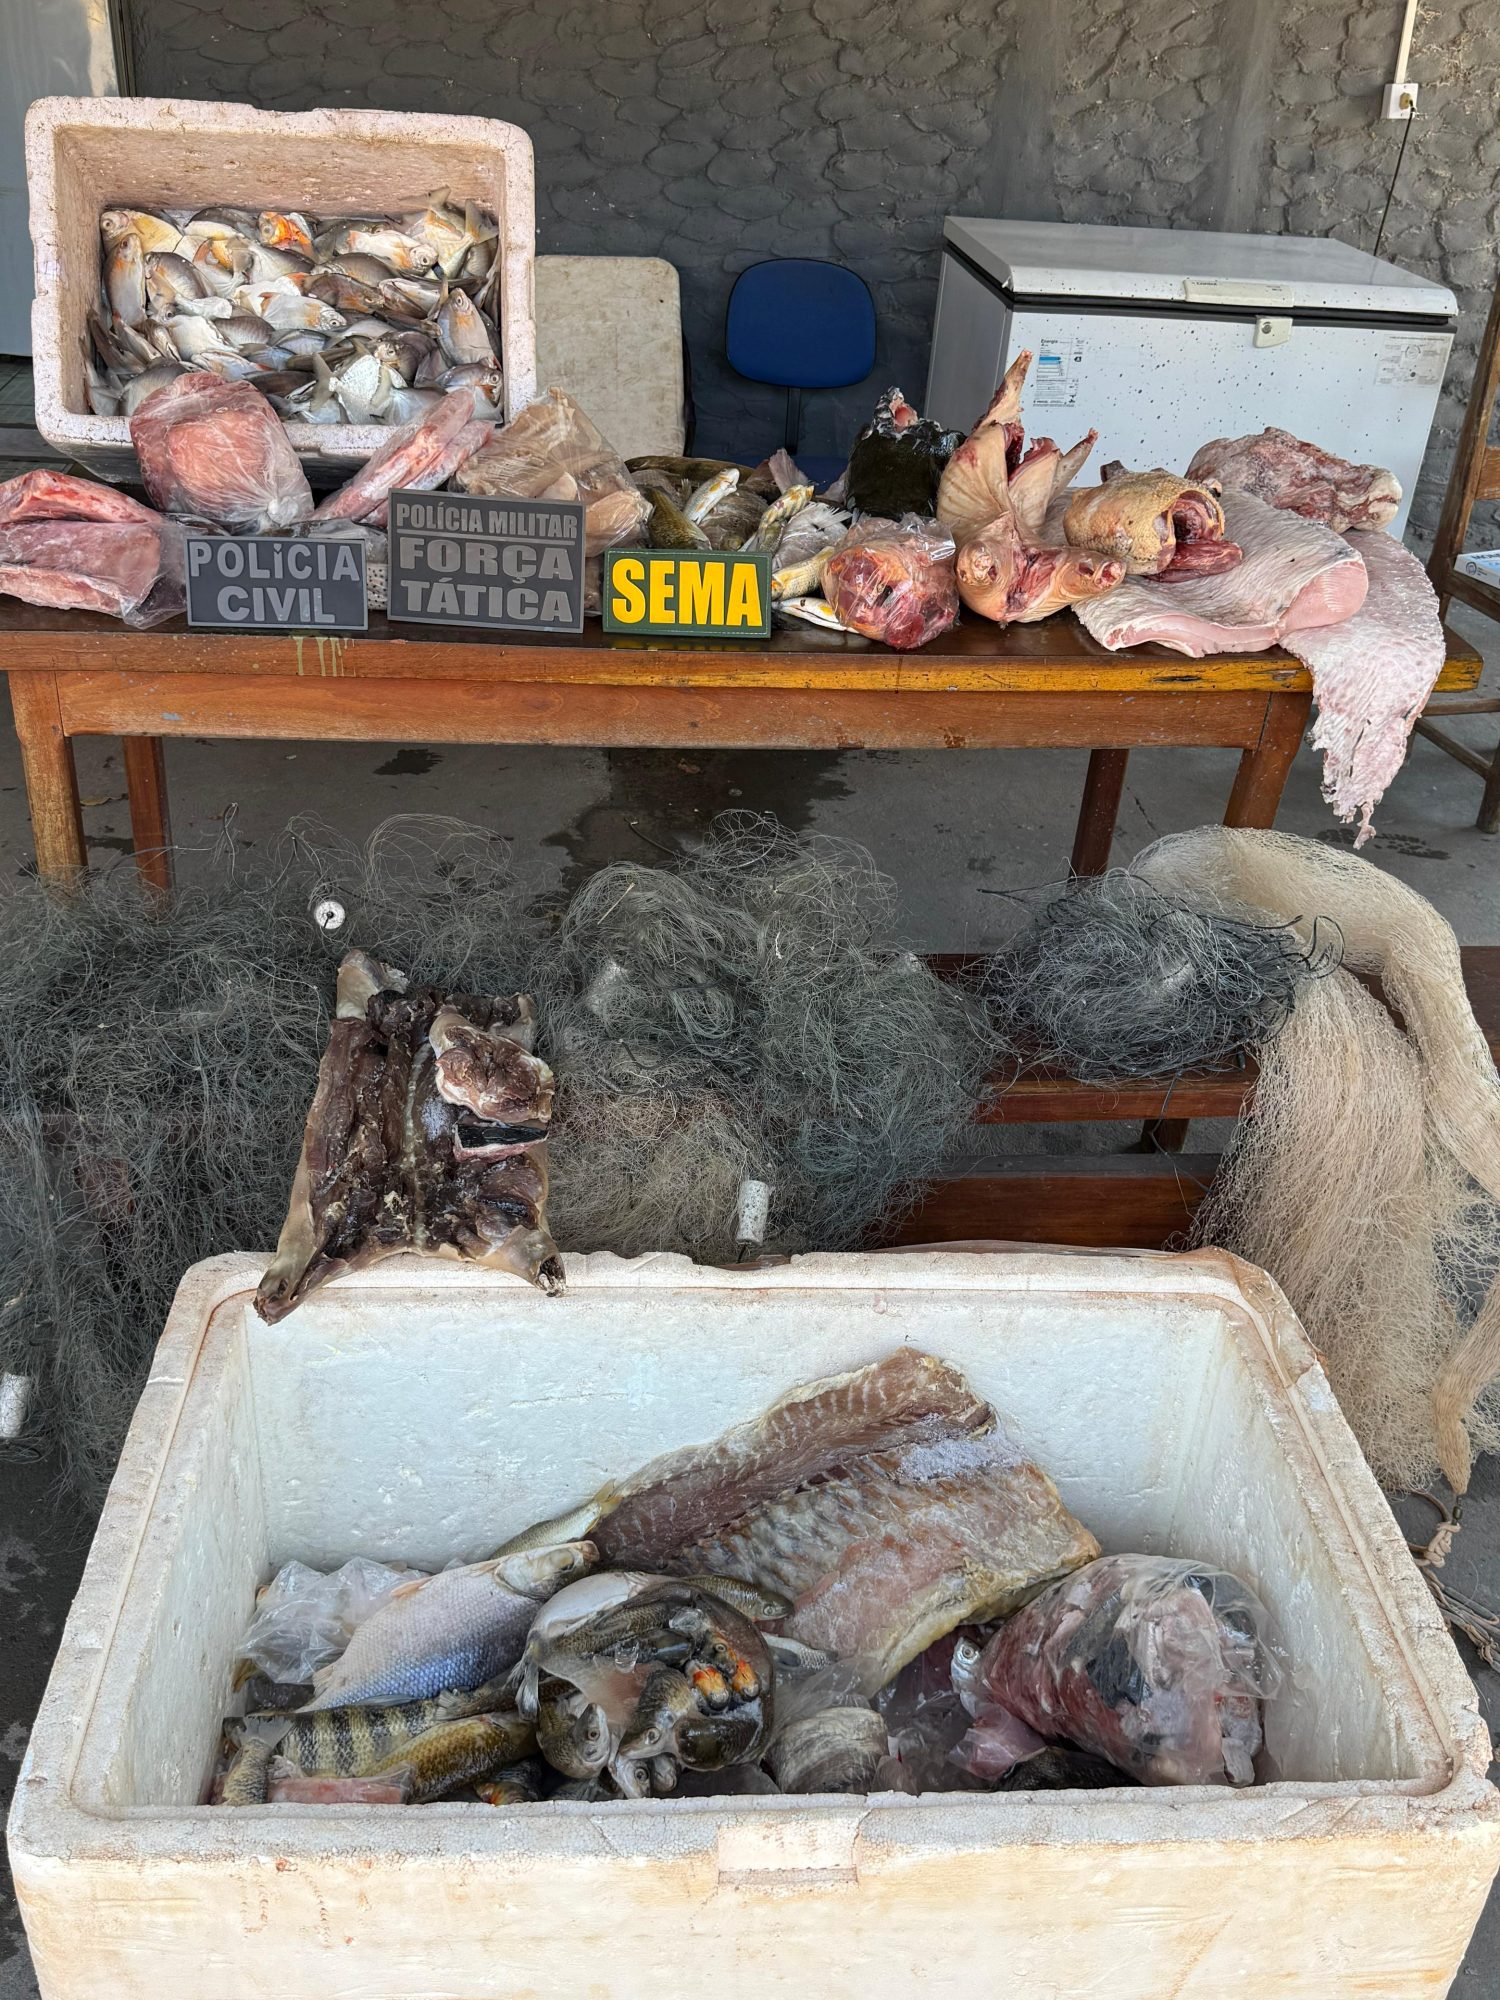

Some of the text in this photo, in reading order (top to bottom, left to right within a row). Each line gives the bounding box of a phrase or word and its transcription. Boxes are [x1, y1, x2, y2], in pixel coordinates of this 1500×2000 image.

[396, 501, 577, 539] POLÍCIA MILITAR
[400, 536, 574, 584] FORÇA
[217, 585, 336, 624] CIVIL
[400, 577, 573, 623] TÁTICA
[612, 558, 763, 627] SEMA
